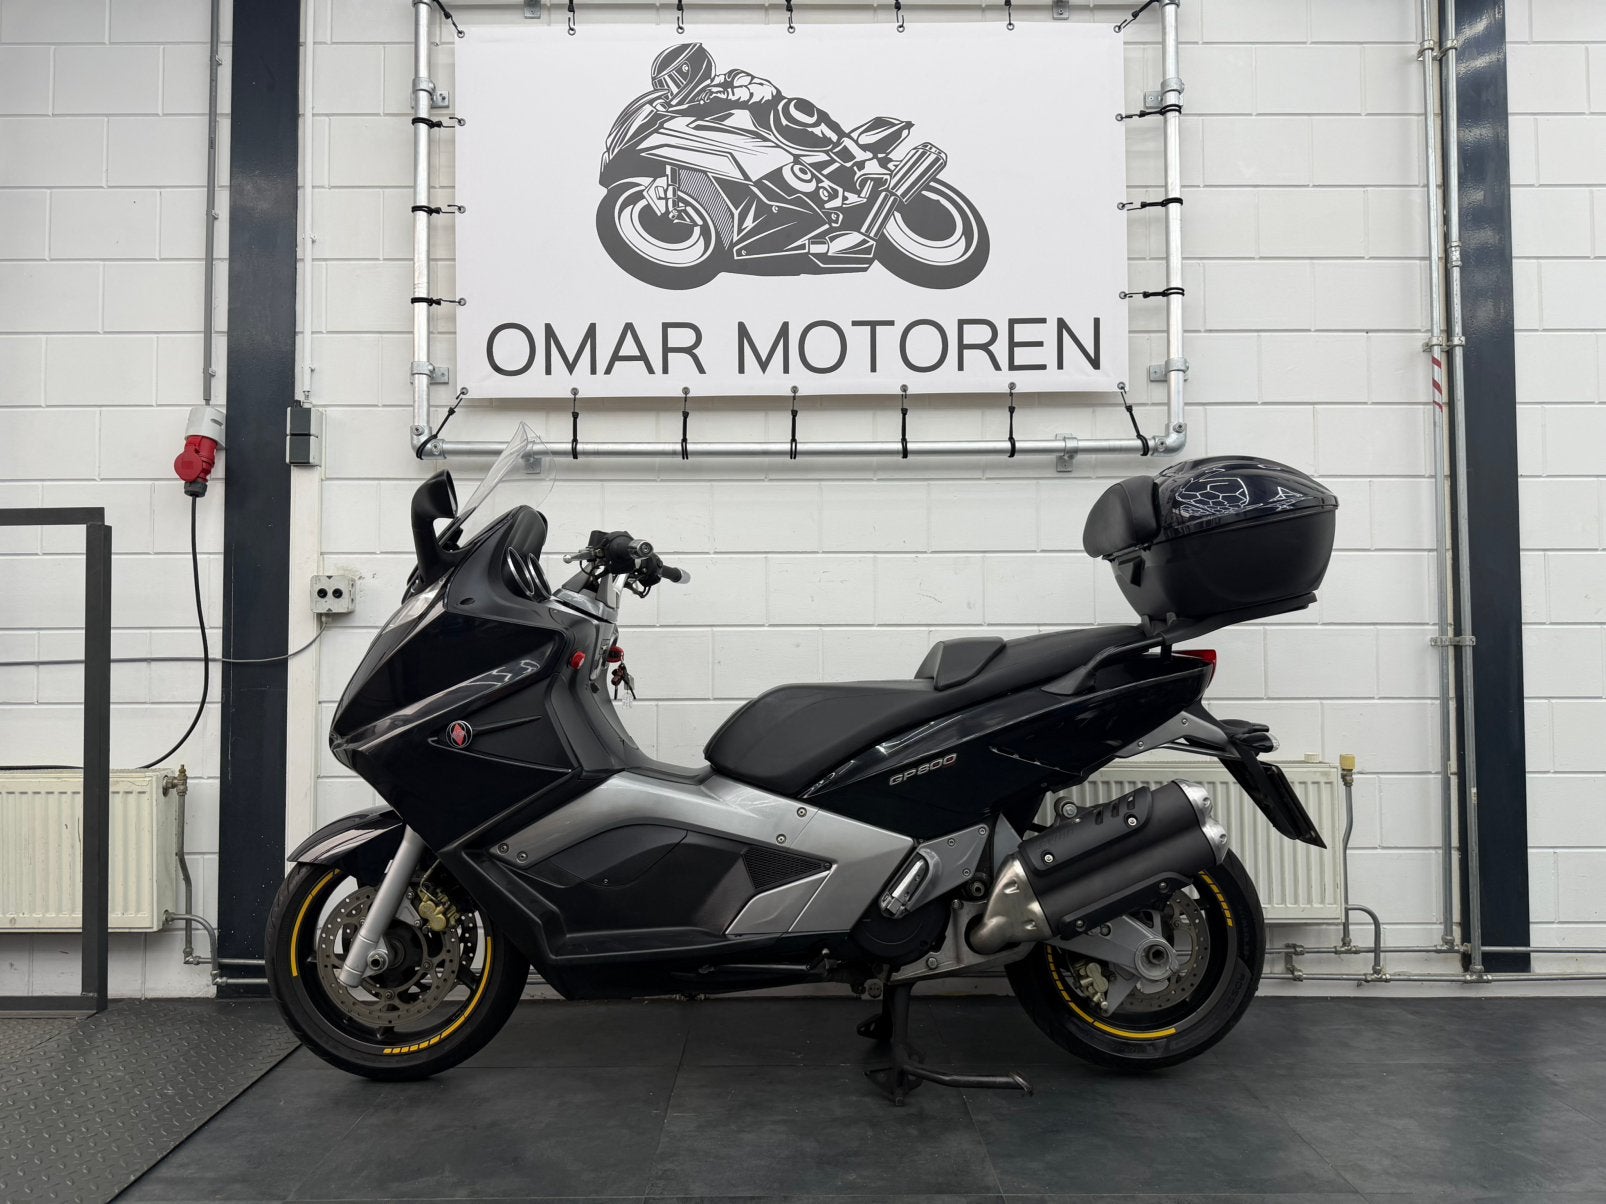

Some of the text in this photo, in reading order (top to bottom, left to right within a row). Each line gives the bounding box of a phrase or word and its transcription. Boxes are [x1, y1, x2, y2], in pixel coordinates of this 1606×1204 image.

[486, 317, 1101, 377] OMAR MOTOREN
[889, 753, 957, 786] GP800
